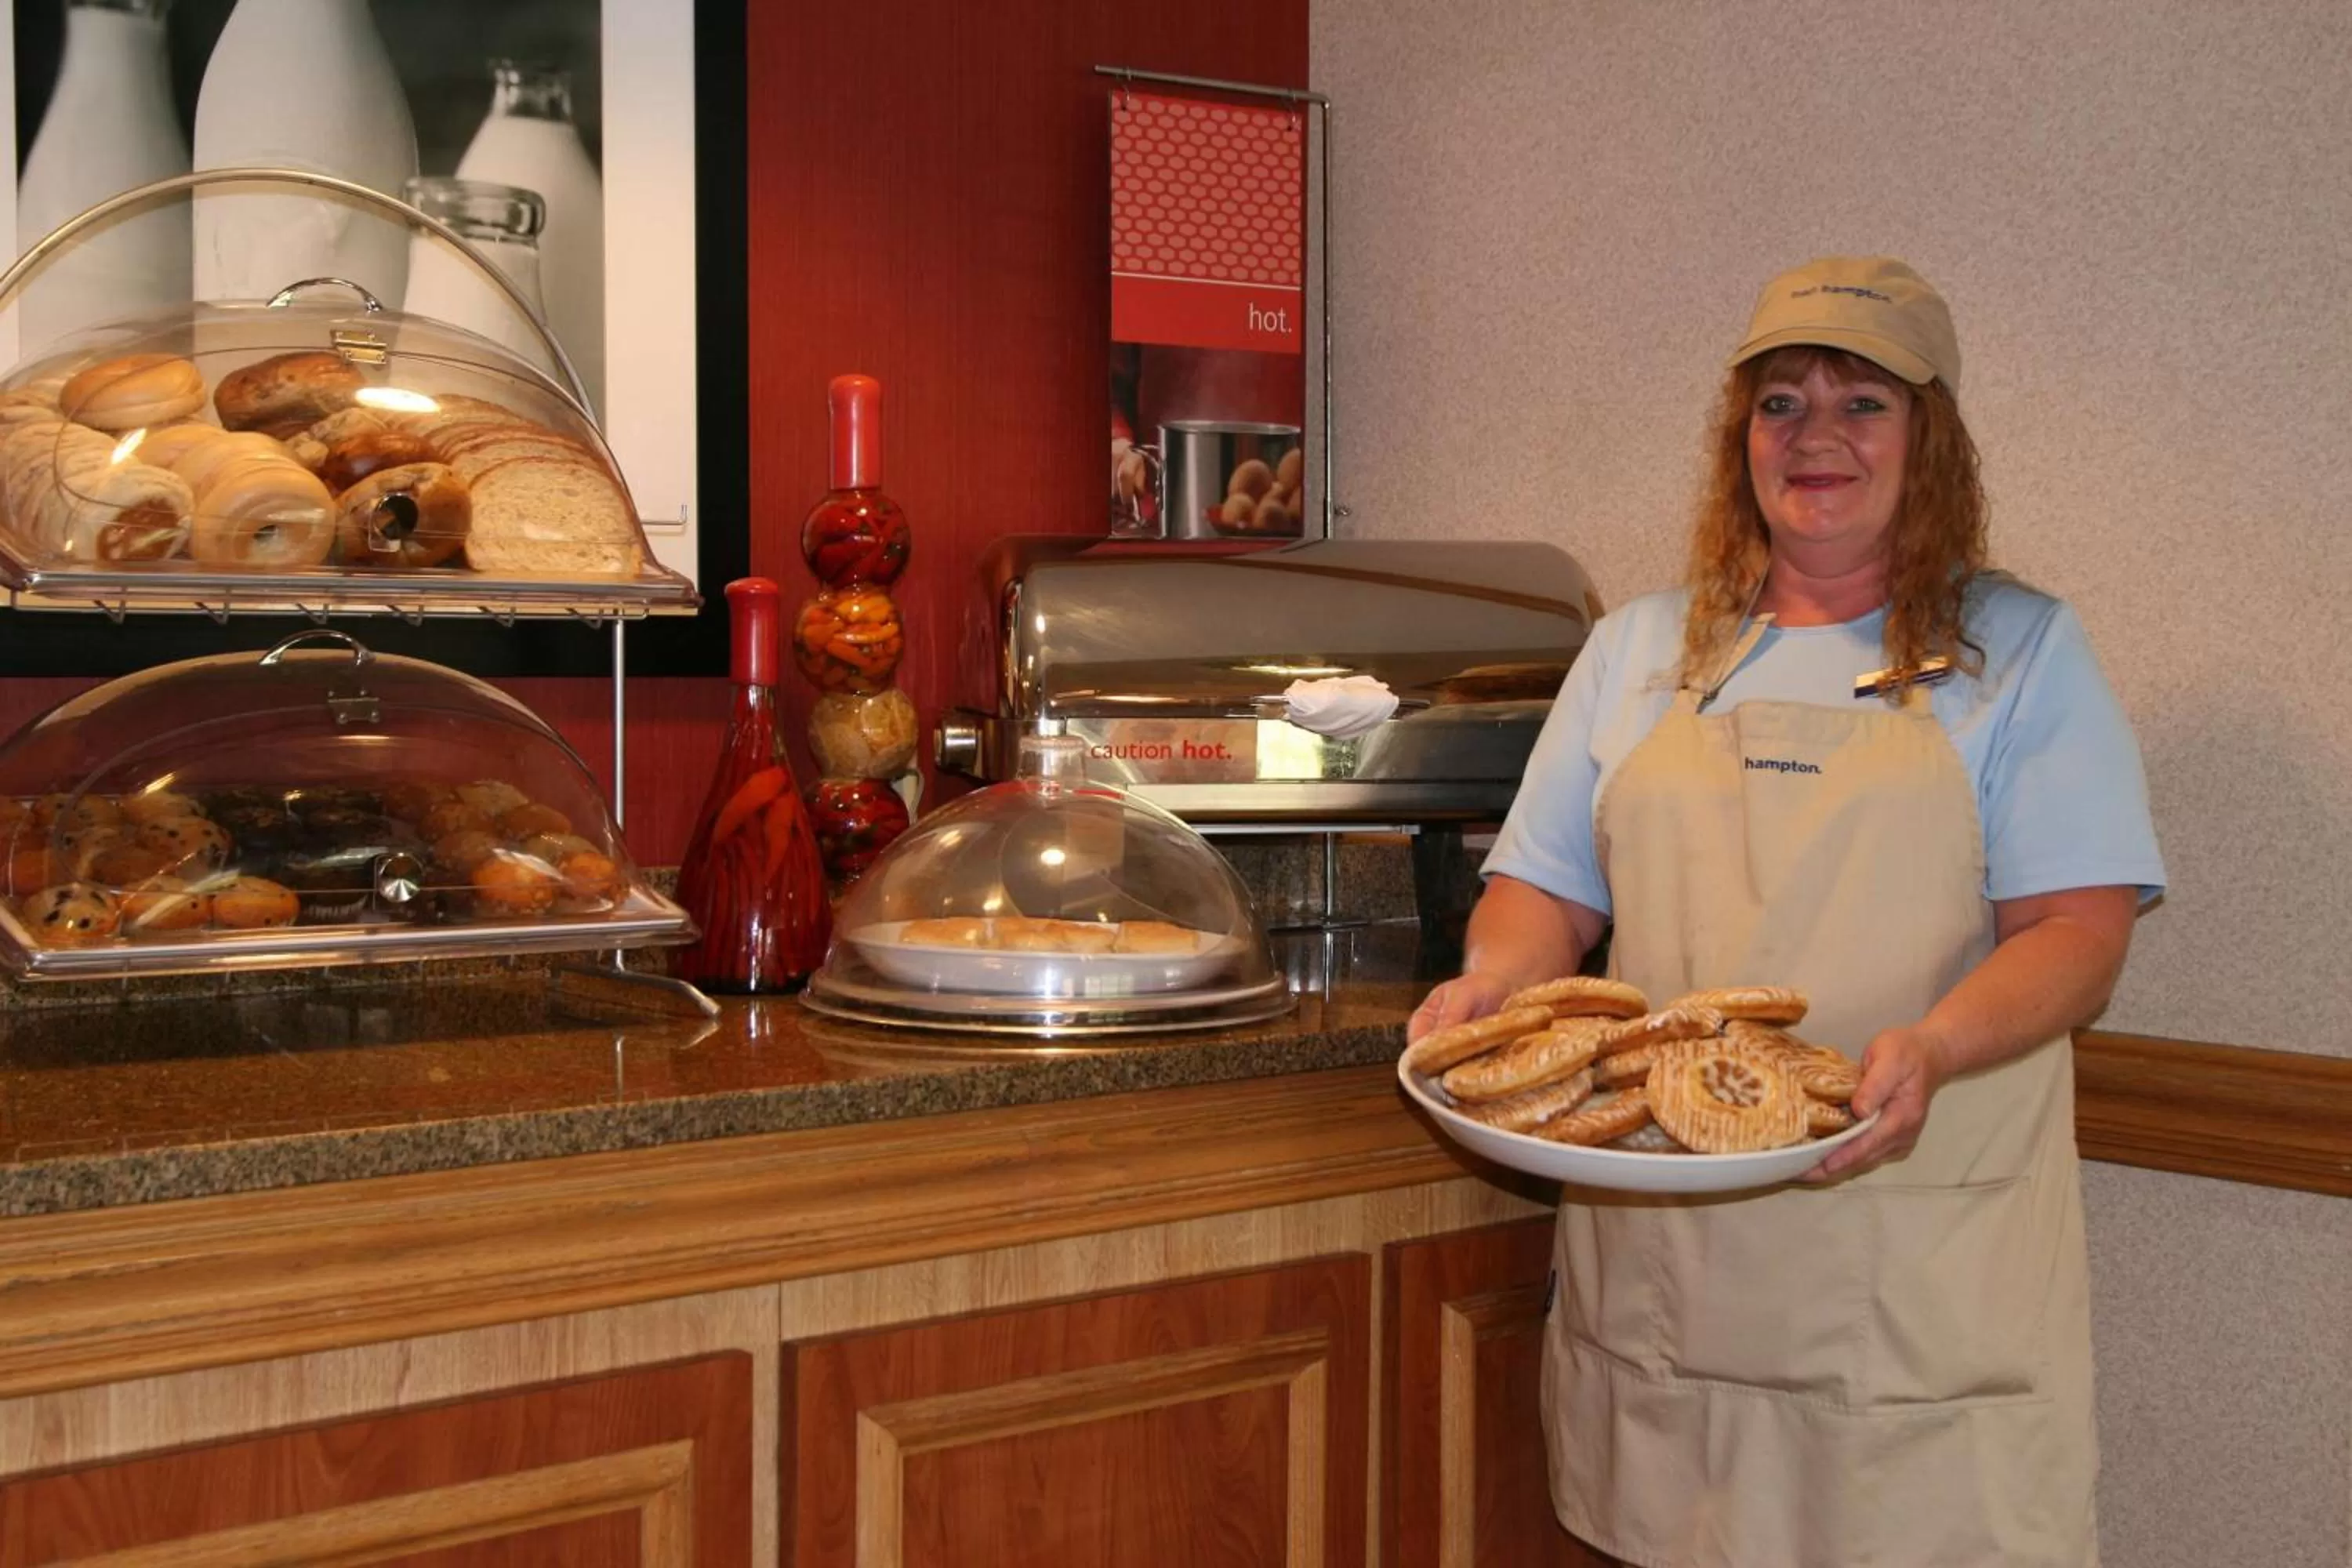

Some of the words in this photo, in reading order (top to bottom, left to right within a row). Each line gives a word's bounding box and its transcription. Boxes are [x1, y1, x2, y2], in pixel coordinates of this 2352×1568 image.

[1248, 302, 1293, 333] hot.
[1091, 739, 1172, 760] caution
[1183, 739, 1232, 760] hot.
[1744, 757, 1822, 775] hampton.
